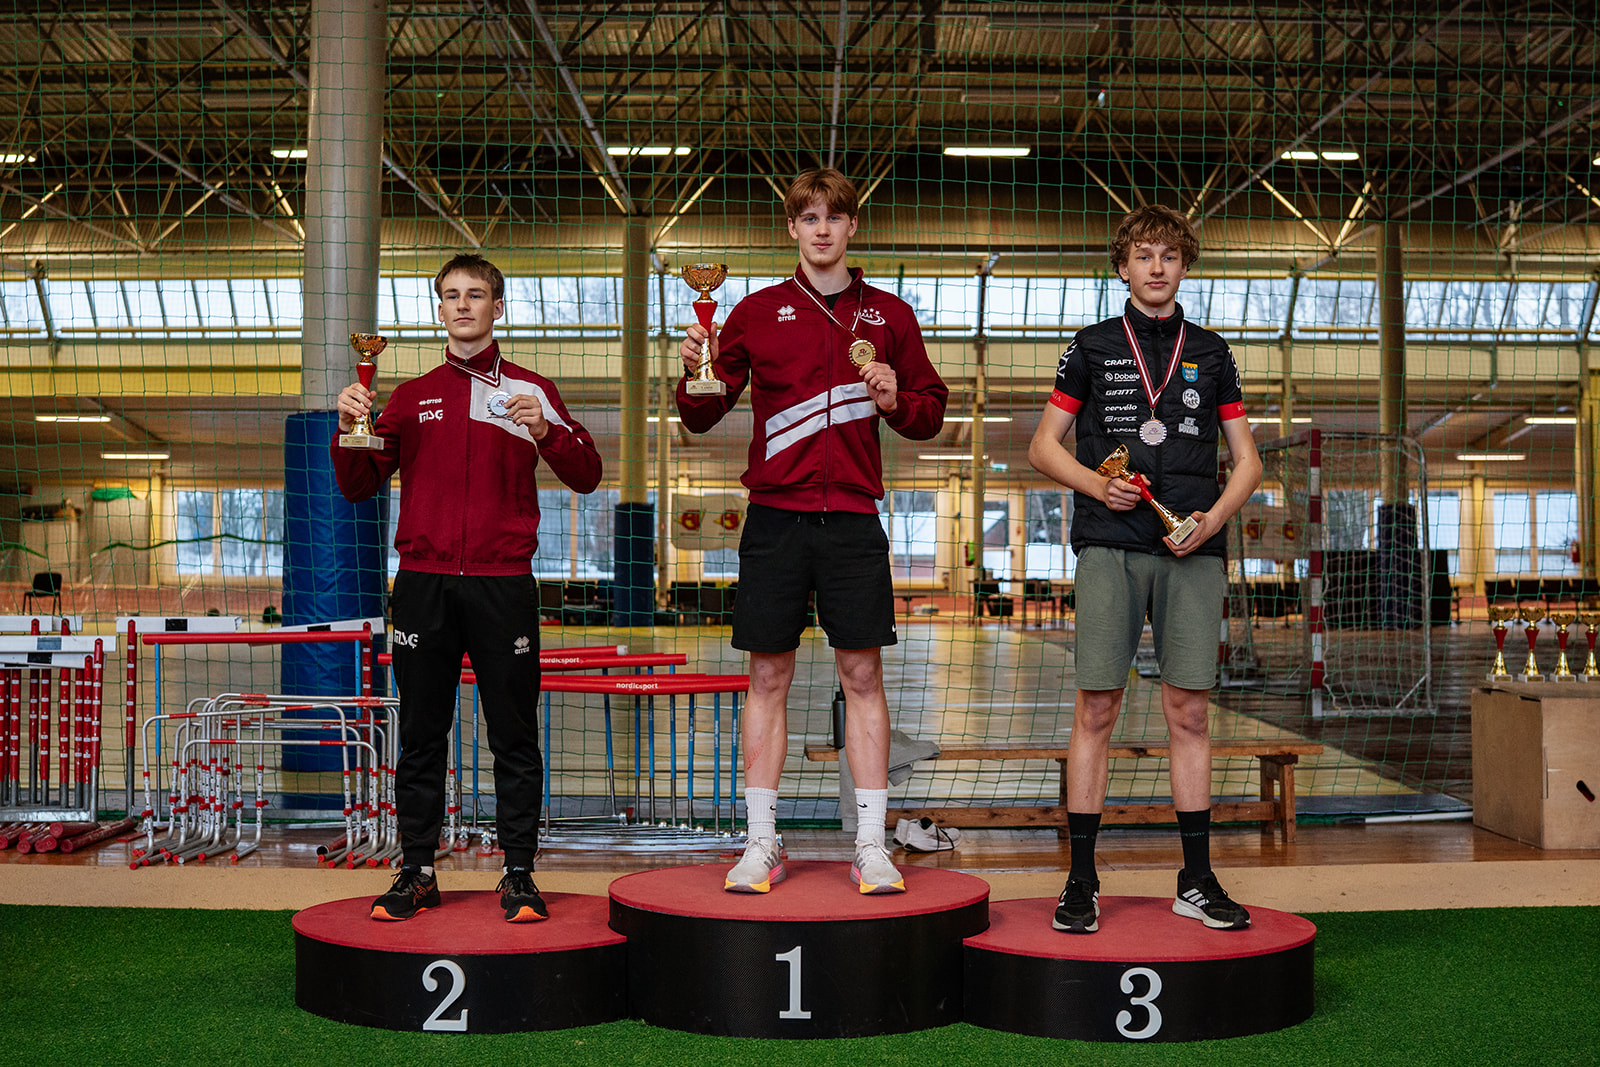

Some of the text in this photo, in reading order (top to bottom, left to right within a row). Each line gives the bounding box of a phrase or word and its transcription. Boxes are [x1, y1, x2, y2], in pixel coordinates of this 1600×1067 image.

[1105, 388, 1137, 396] GIANT
[540, 657, 580, 665] nordicsport
[616, 682, 658, 690] nordicsport
[422, 959, 468, 1031] 2
[775, 946, 811, 1019] 1
[1116, 967, 1162, 1039] 3
